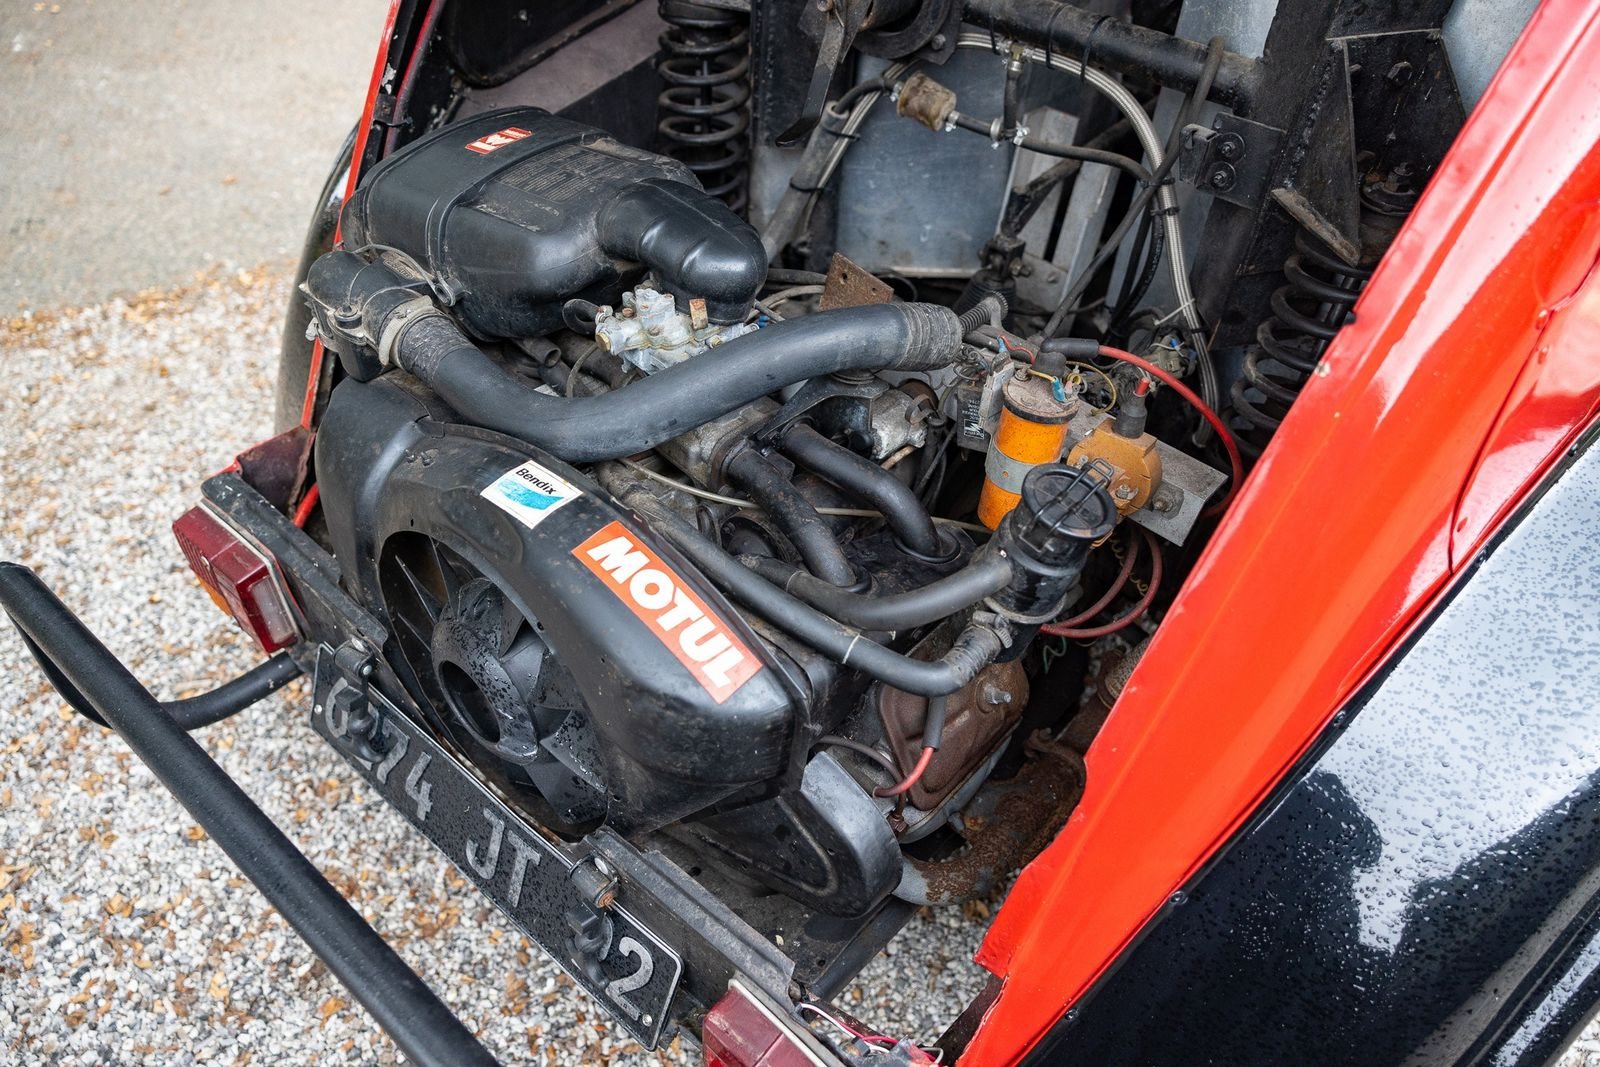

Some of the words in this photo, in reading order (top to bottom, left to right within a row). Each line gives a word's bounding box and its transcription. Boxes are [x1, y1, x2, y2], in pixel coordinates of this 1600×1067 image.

[515, 467, 557, 495] Bendix
[586, 535, 745, 688] MOTUL
[465, 808, 542, 907] JT
